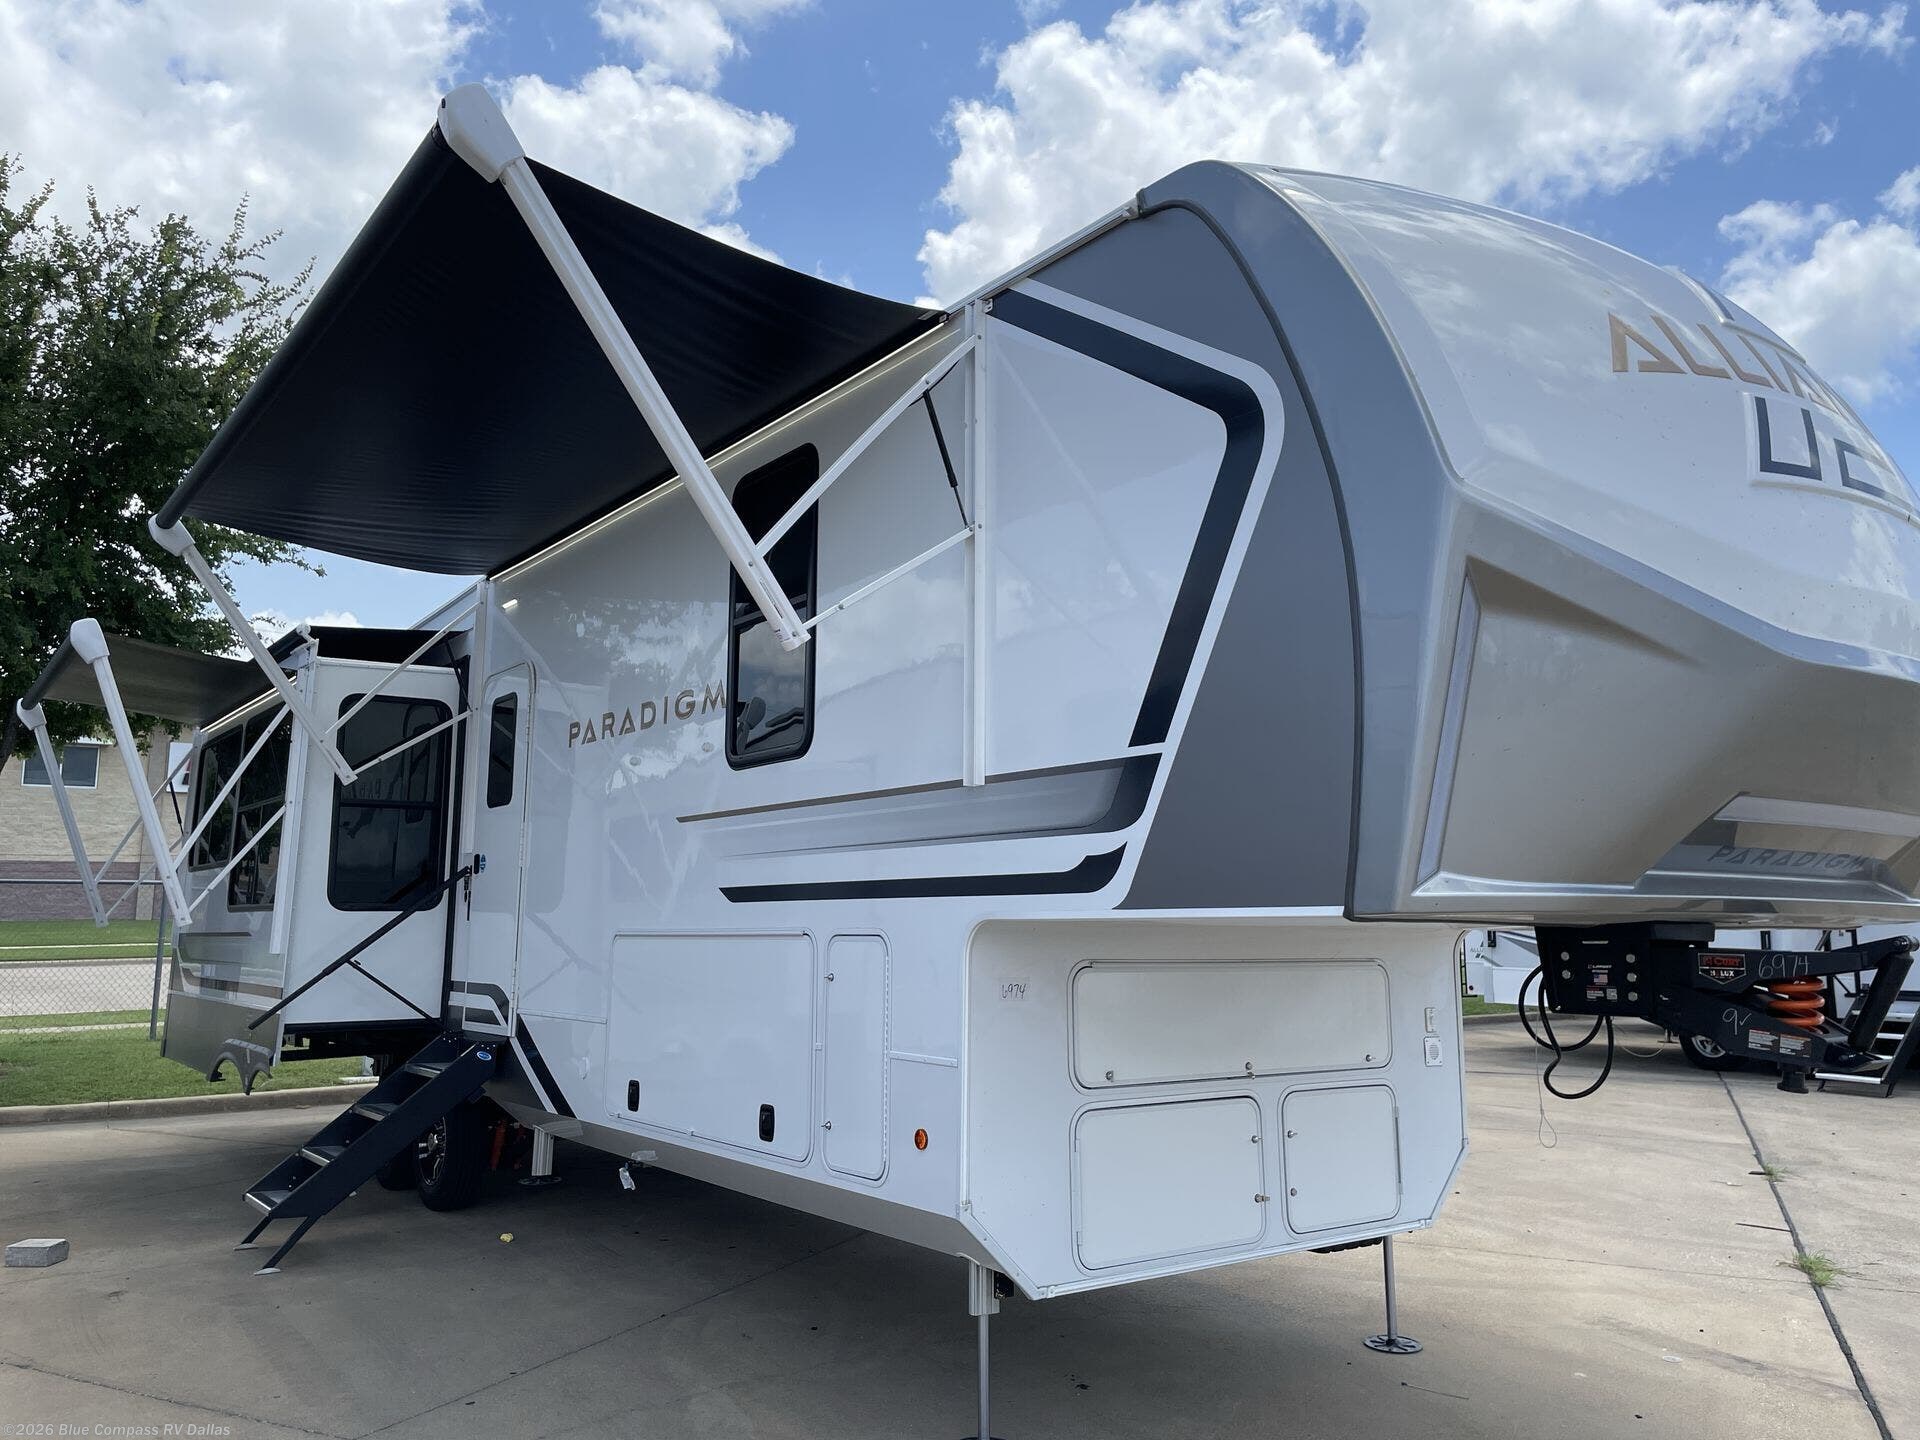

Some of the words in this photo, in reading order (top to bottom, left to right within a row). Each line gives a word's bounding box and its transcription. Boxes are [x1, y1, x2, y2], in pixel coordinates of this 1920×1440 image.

[568, 679, 727, 749] PARADIGM
[1706, 844, 1869, 870] PARADIGM
[1001, 983, 1027, 999] 6974
